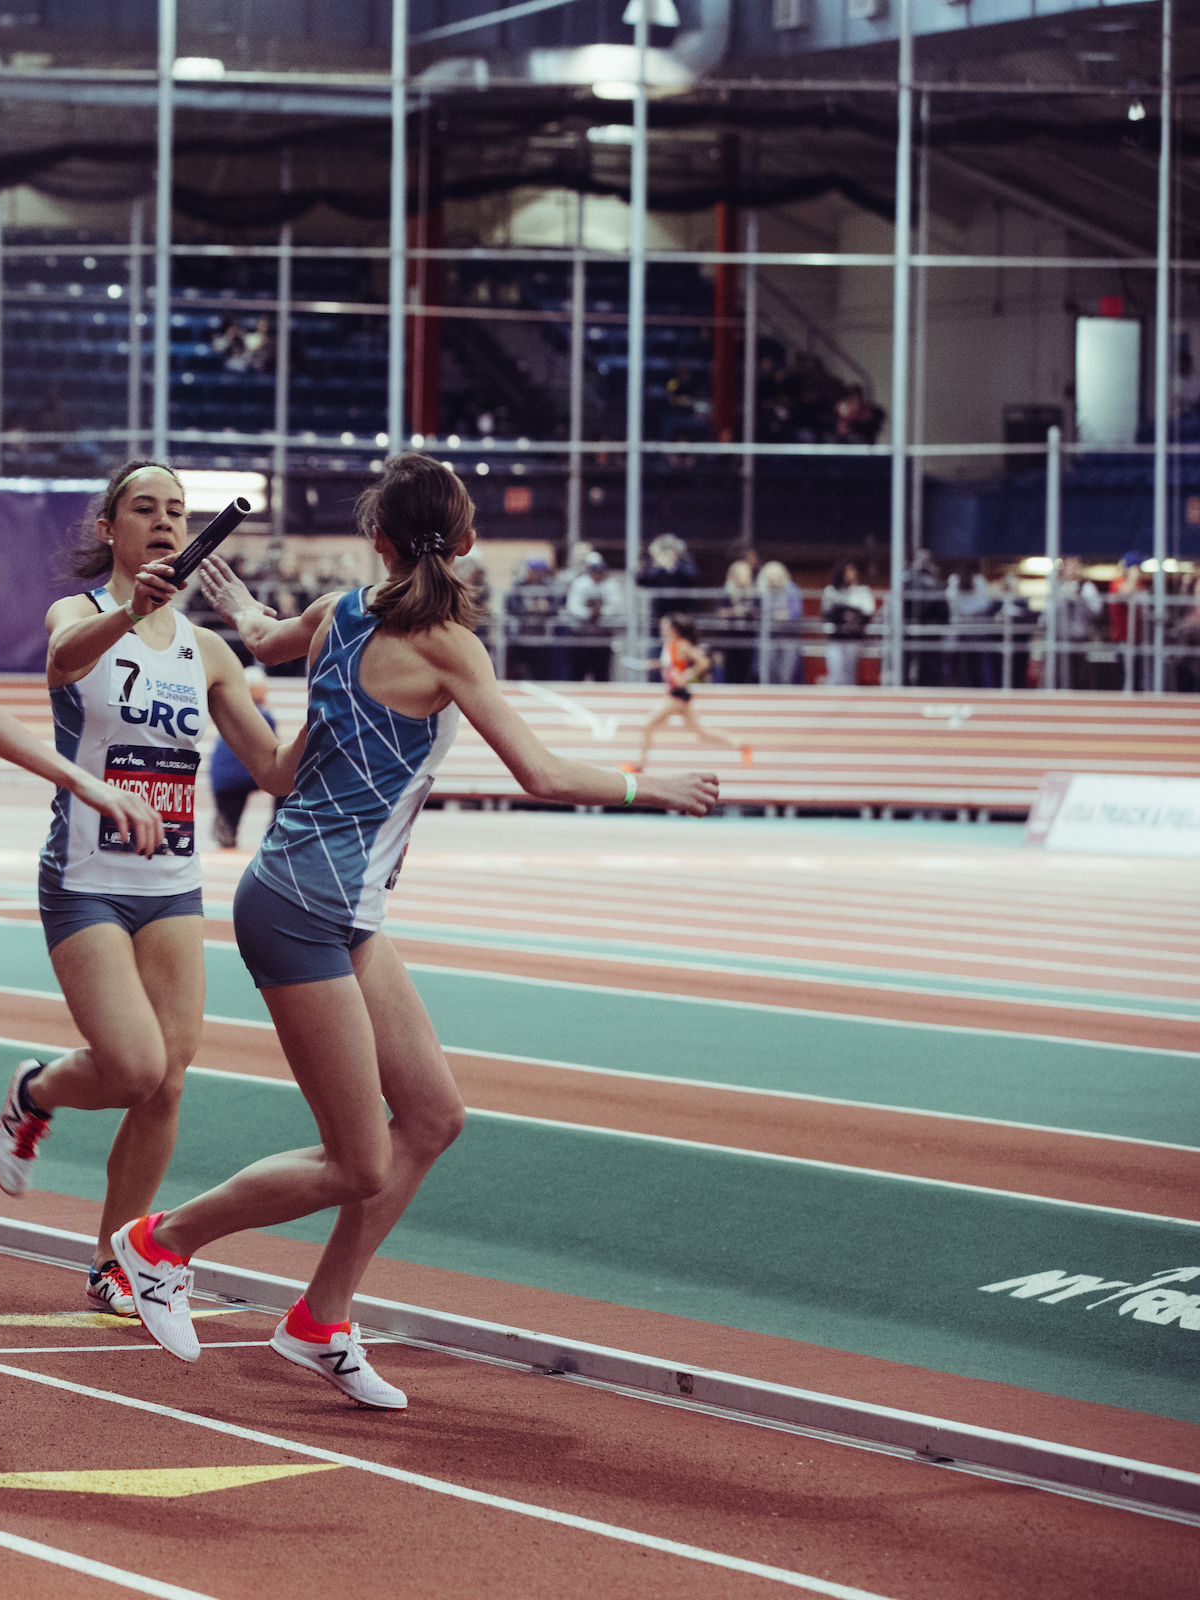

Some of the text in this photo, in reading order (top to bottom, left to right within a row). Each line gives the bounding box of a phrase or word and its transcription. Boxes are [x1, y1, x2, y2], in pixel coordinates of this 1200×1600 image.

[115, 658, 141, 703] 7
[156, 680, 197, 696] PACERS
[157, 689, 199, 705] RUNNING
[120, 699, 199, 739] GRC
[107, 778, 173, 813] RS/GRC
